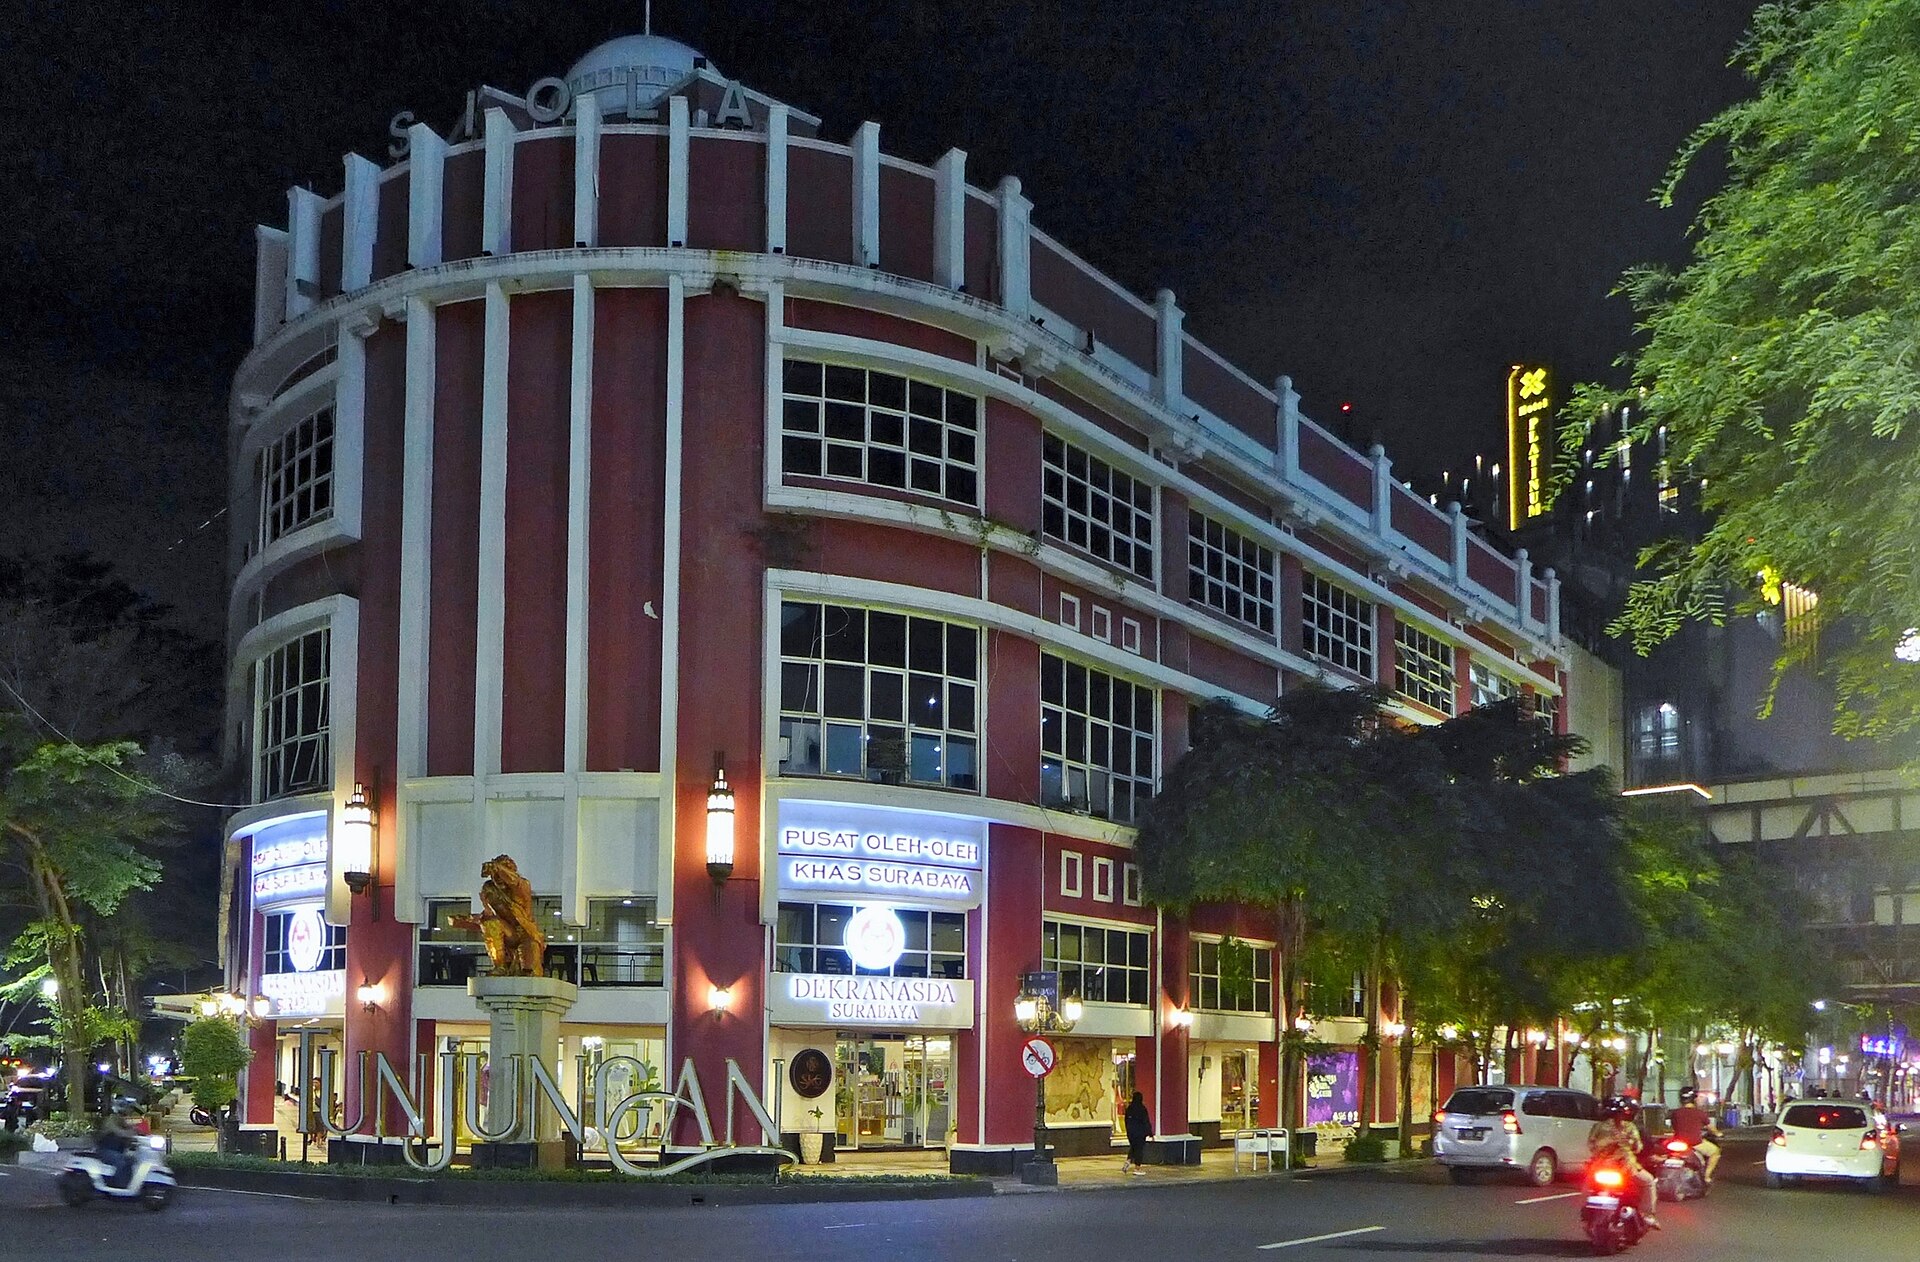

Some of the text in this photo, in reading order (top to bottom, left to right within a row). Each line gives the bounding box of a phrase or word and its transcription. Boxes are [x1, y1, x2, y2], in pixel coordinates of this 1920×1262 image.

[388, 72, 754, 158] SIOLA
[1528, 417, 1541, 517] PLATINUM
[786, 830, 978, 860] PUSAT OLEH-OLEH
[795, 863, 972, 891] KHAS SURABAYA
[795, 978, 956, 1003] DEKRANASDA
[832, 1003, 918, 1019] SURABAYA
[278, 1027, 799, 1176] TUNJUNGAN
